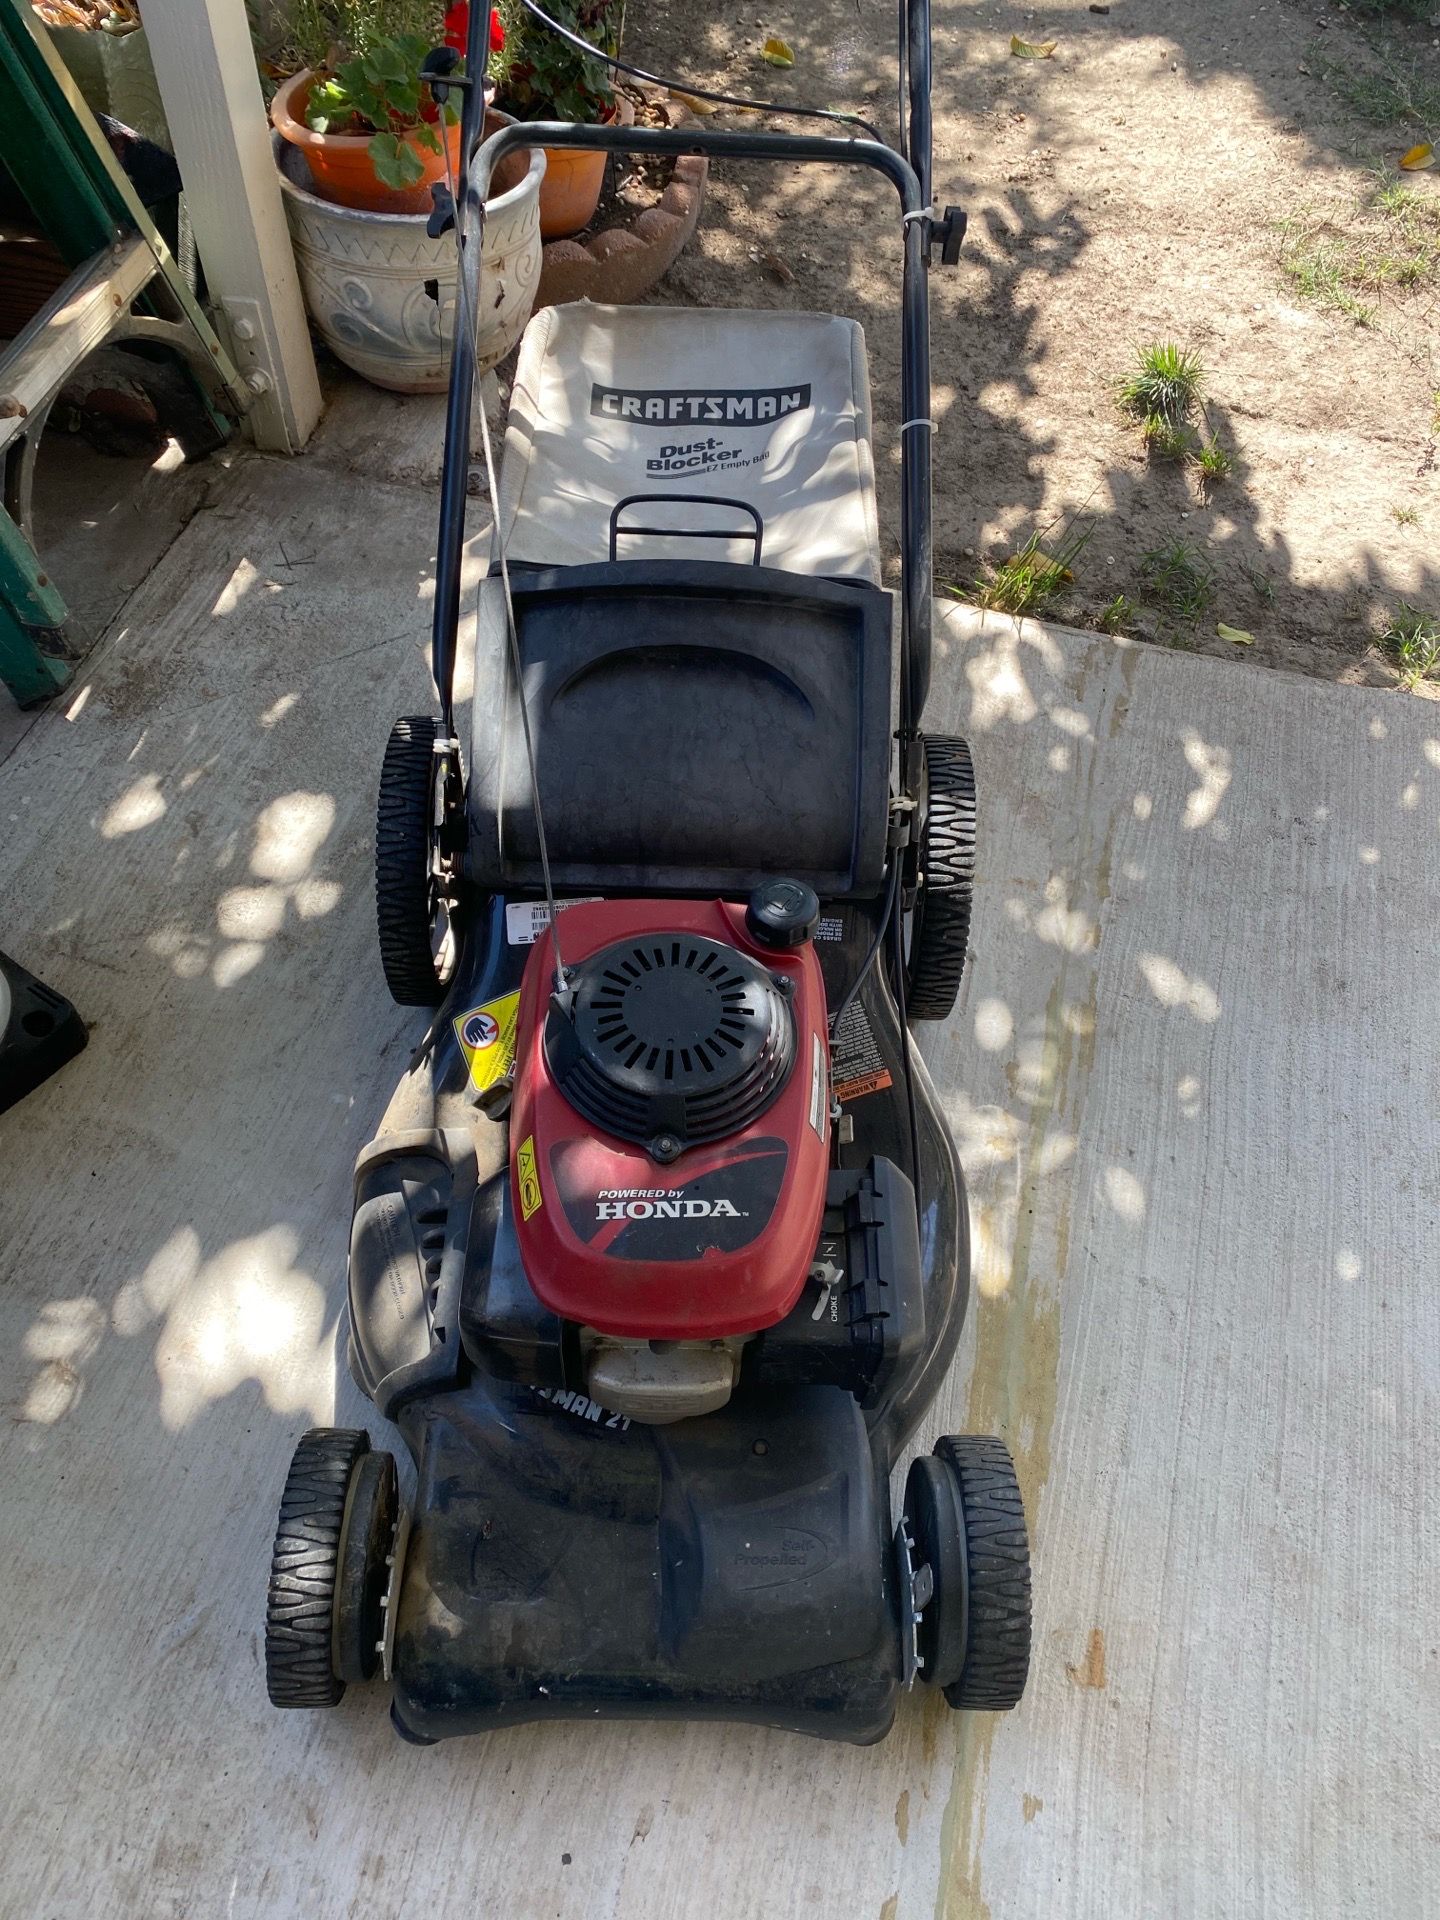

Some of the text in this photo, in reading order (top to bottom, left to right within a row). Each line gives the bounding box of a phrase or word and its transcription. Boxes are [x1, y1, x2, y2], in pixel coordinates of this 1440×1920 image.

[601, 392, 801, 420] CRAFTSMAN
[660, 438, 723, 458] Dust-
[646, 449, 742, 470] Blocker
[706, 451, 770, 473] EZ Empty Bag
[840, 1084, 869, 1098] WARNING
[597, 1189, 684, 1199] POWERED by
[595, 1200, 741, 1220] HONDA
[830, 1295, 838, 1322] CHOKE
[605, 1410, 632, 1431] 21
[734, 1554, 807, 1568] Propelled
